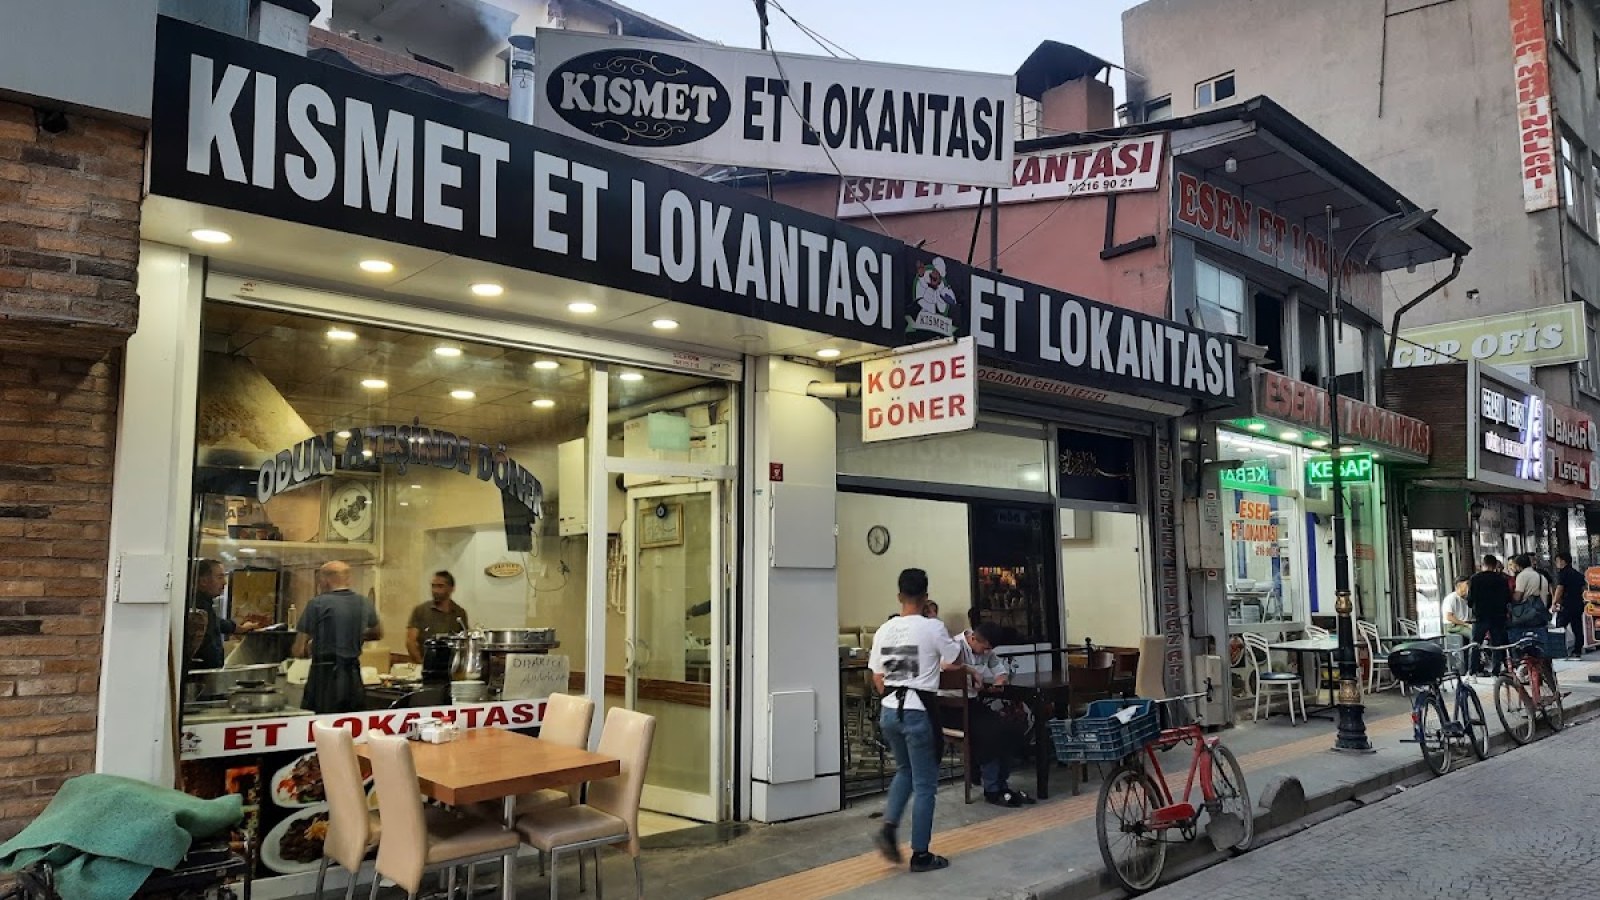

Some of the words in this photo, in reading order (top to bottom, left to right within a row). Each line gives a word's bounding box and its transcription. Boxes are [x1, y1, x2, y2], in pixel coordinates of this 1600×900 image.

[559, 70, 718, 124] KISMET
[743, 75, 789, 143] ET
[801, 81, 1005, 162] LOKANTASI
[187, 53, 510, 239] KISMET
[533, 150, 609, 262] ET
[631, 179, 893, 330] LOKANTASI
[843, 177, 905, 204] ESEN
[1079, 180, 1099, 191] 216
[1103, 179, 1117, 190] 90
[1120, 177, 1133, 188] 21
[1177, 172, 1253, 247] ESEN
[1257, 207, 1287, 261] ET
[919, 315, 950, 333] KISMET
[970, 274, 1024, 354] ET
[1038, 293, 1235, 399] LOKANTASI
[1471, 321, 1563, 361] OFİS
[867, 355, 966, 394] KÖZDE
[868, 393, 966, 429] DÖNER
[1555, 418, 1588, 450] BAHAR
[257, 430, 335, 505] ODUN
[1239, 500, 1270, 520] ESEN
[224, 722, 287, 751] ET
